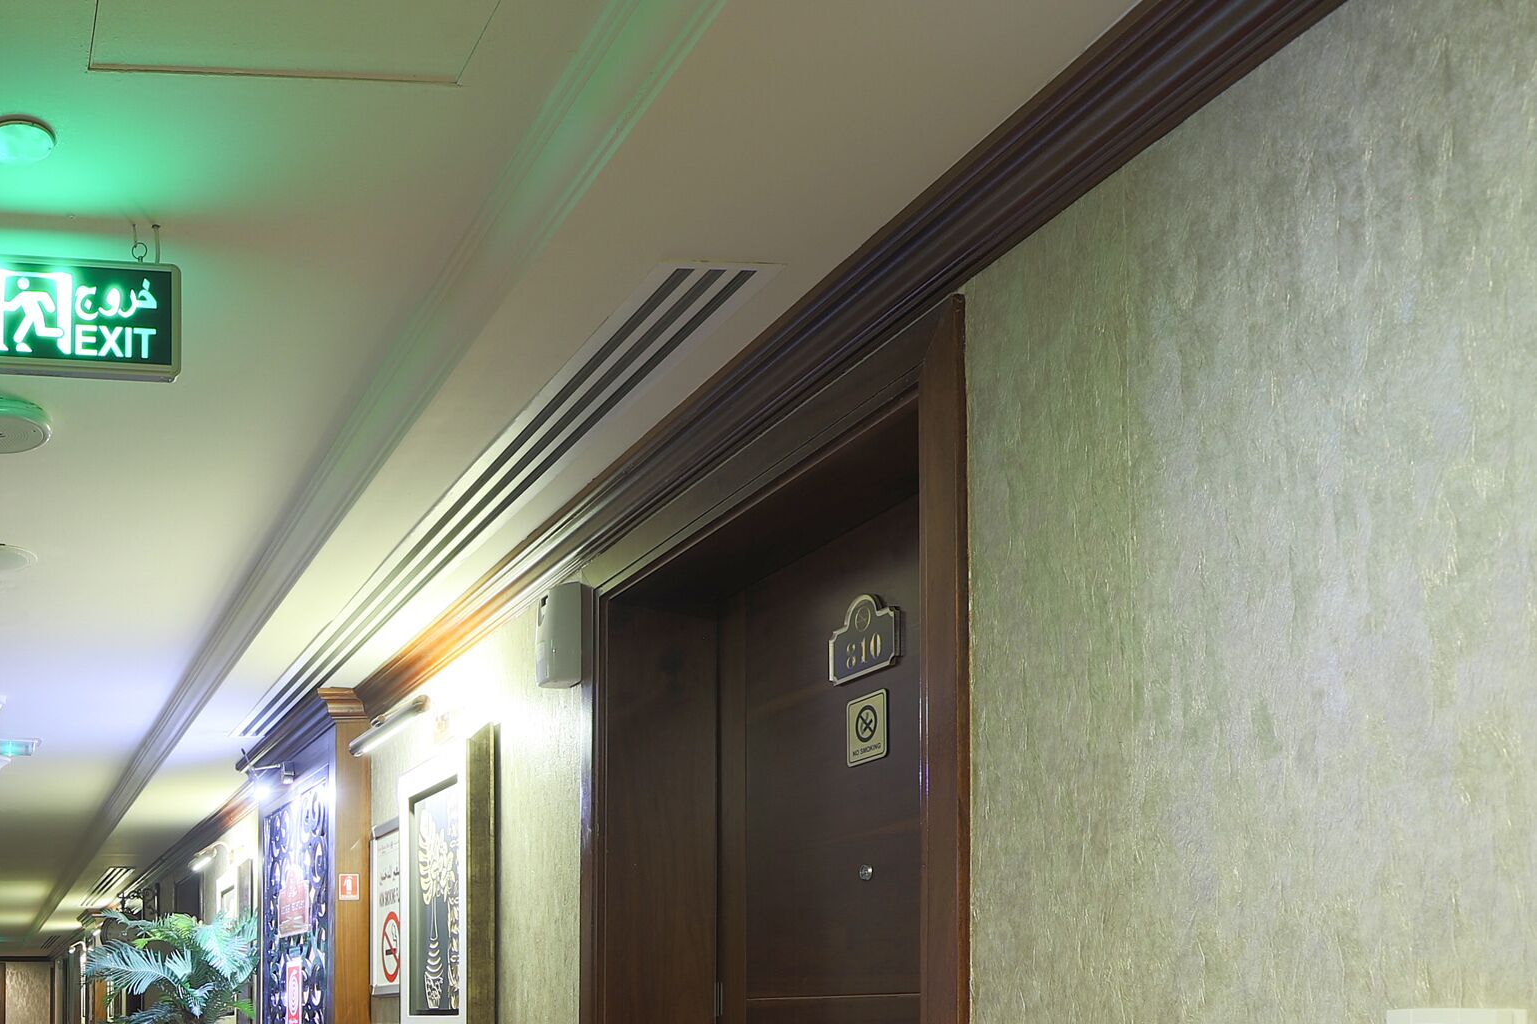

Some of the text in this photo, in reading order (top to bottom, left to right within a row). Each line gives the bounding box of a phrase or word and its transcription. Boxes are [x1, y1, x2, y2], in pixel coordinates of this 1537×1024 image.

[75, 278, 157, 321] خروج
[75, 324, 157, 359] EXIT
[846, 632, 882, 670] 810
[860, 742, 882, 755] SMOKING
